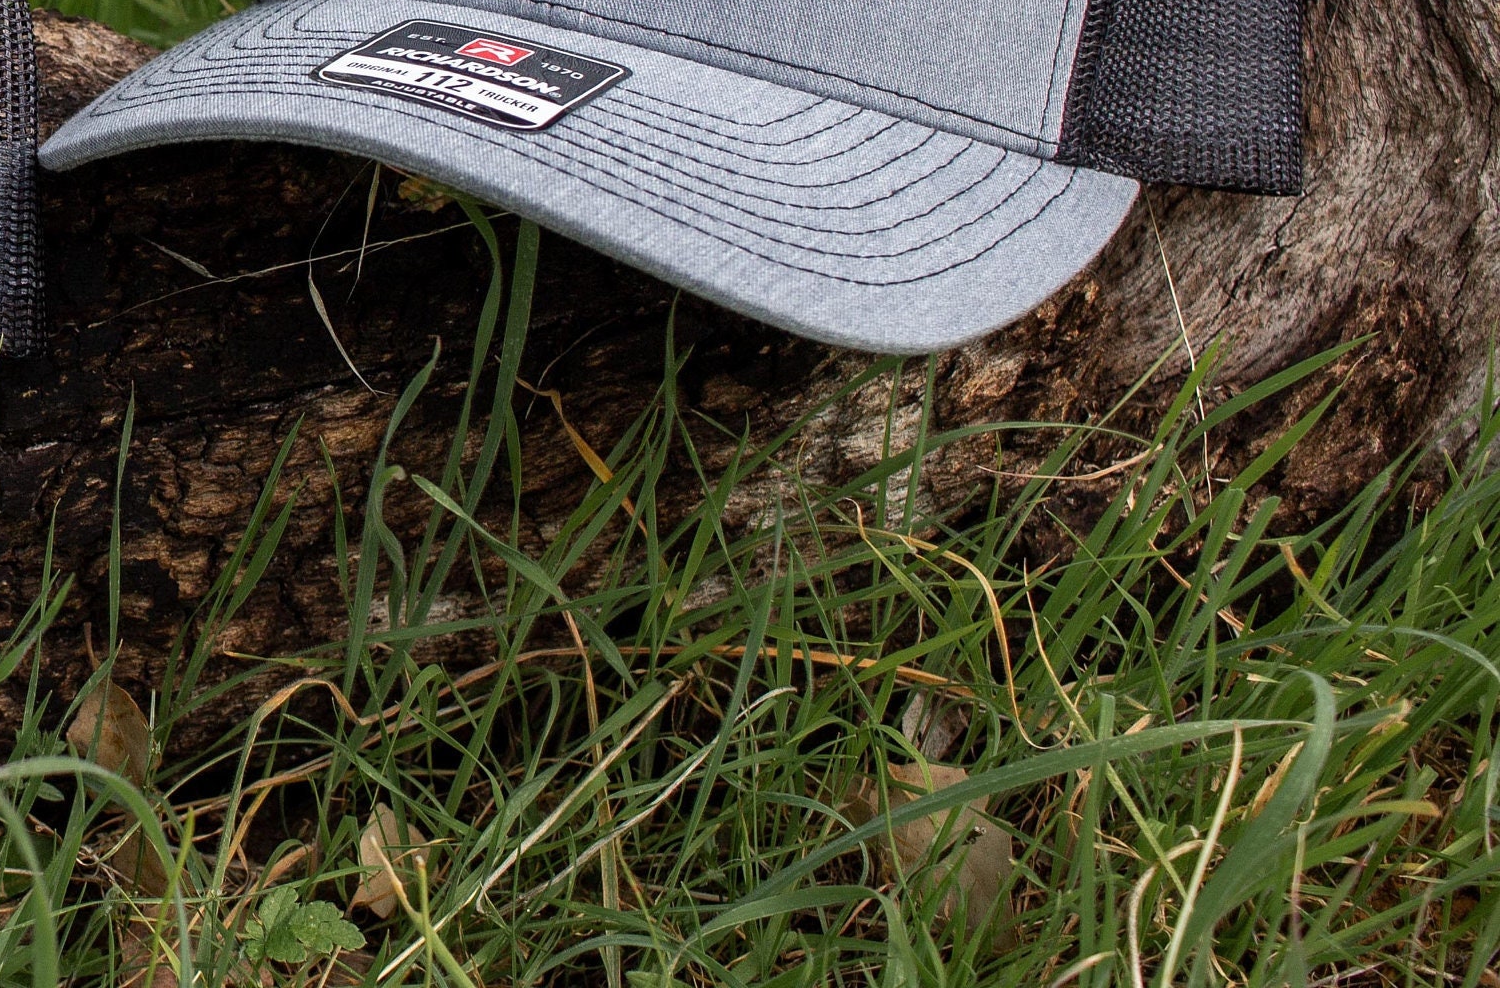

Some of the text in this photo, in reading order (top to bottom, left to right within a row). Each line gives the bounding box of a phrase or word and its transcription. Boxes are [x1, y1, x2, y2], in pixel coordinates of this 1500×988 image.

[346, 61, 538, 113] ORIGINAL 112 TRUCKER
[378, 46, 559, 97] RICHARDSON
[540, 61, 584, 80] 1970
[371, 79, 477, 111] ADJUSTABLE
